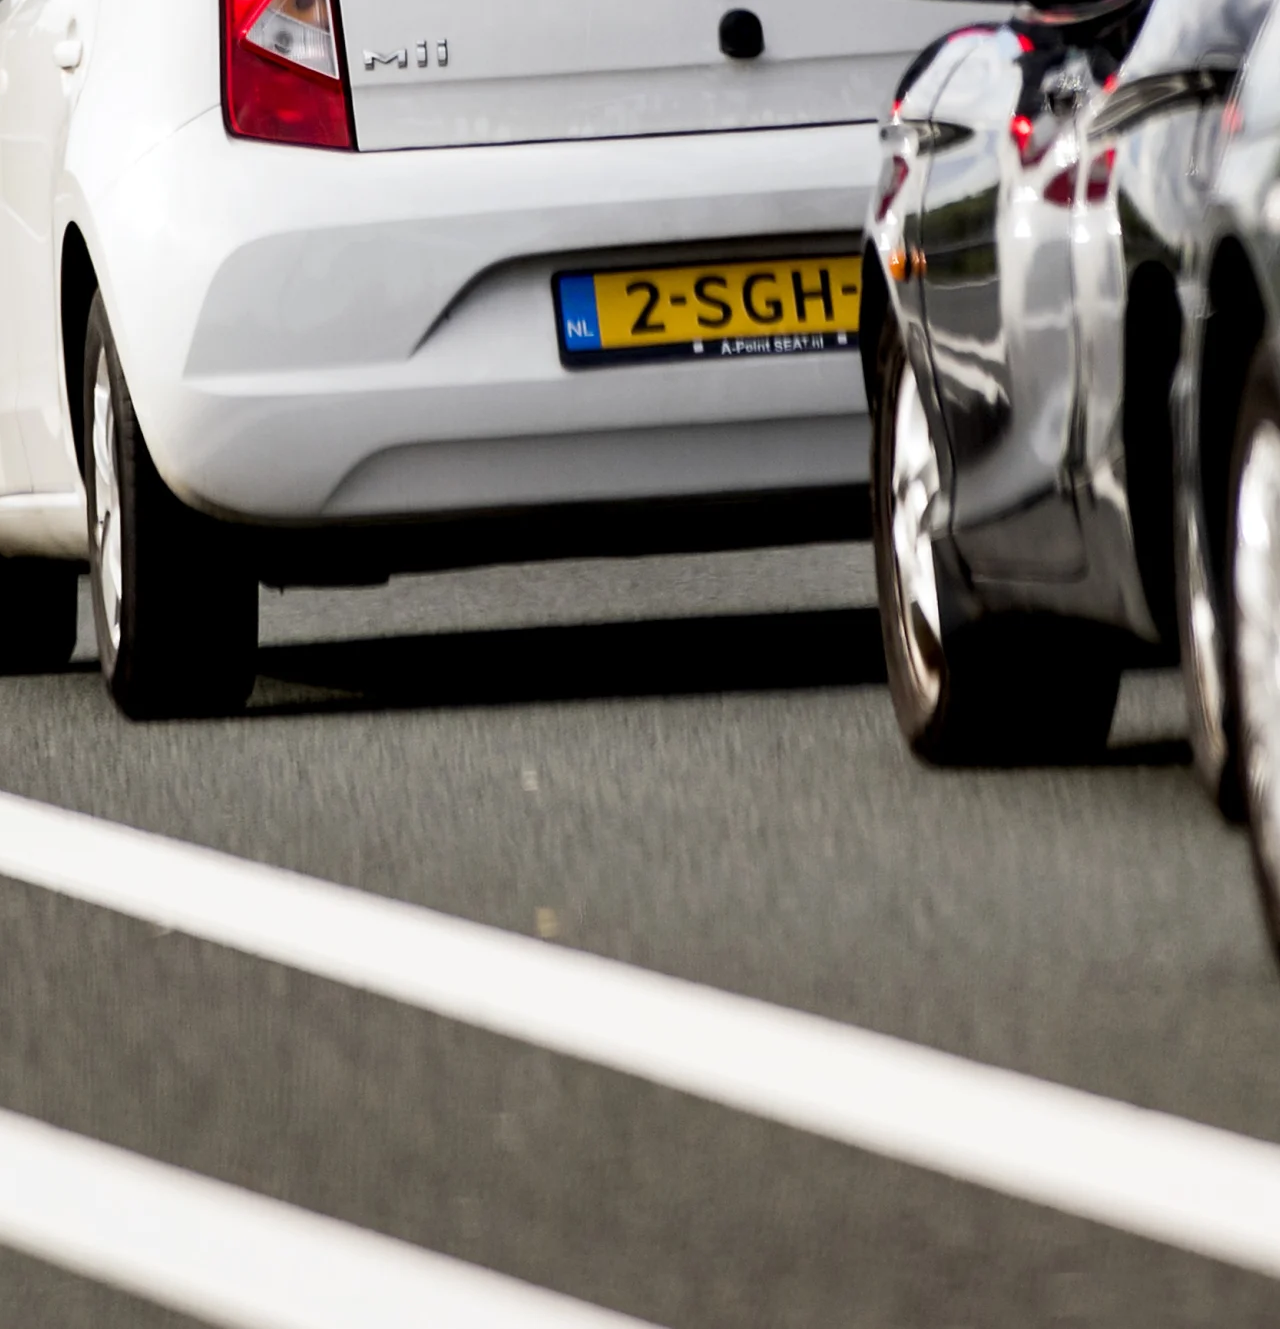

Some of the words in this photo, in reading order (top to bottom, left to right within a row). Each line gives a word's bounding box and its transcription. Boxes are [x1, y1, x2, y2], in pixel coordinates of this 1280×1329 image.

[363, 38, 449, 71] Mii
[625, 268, 858, 336] 2-SGH-
[567, 319, 595, 338] NL
